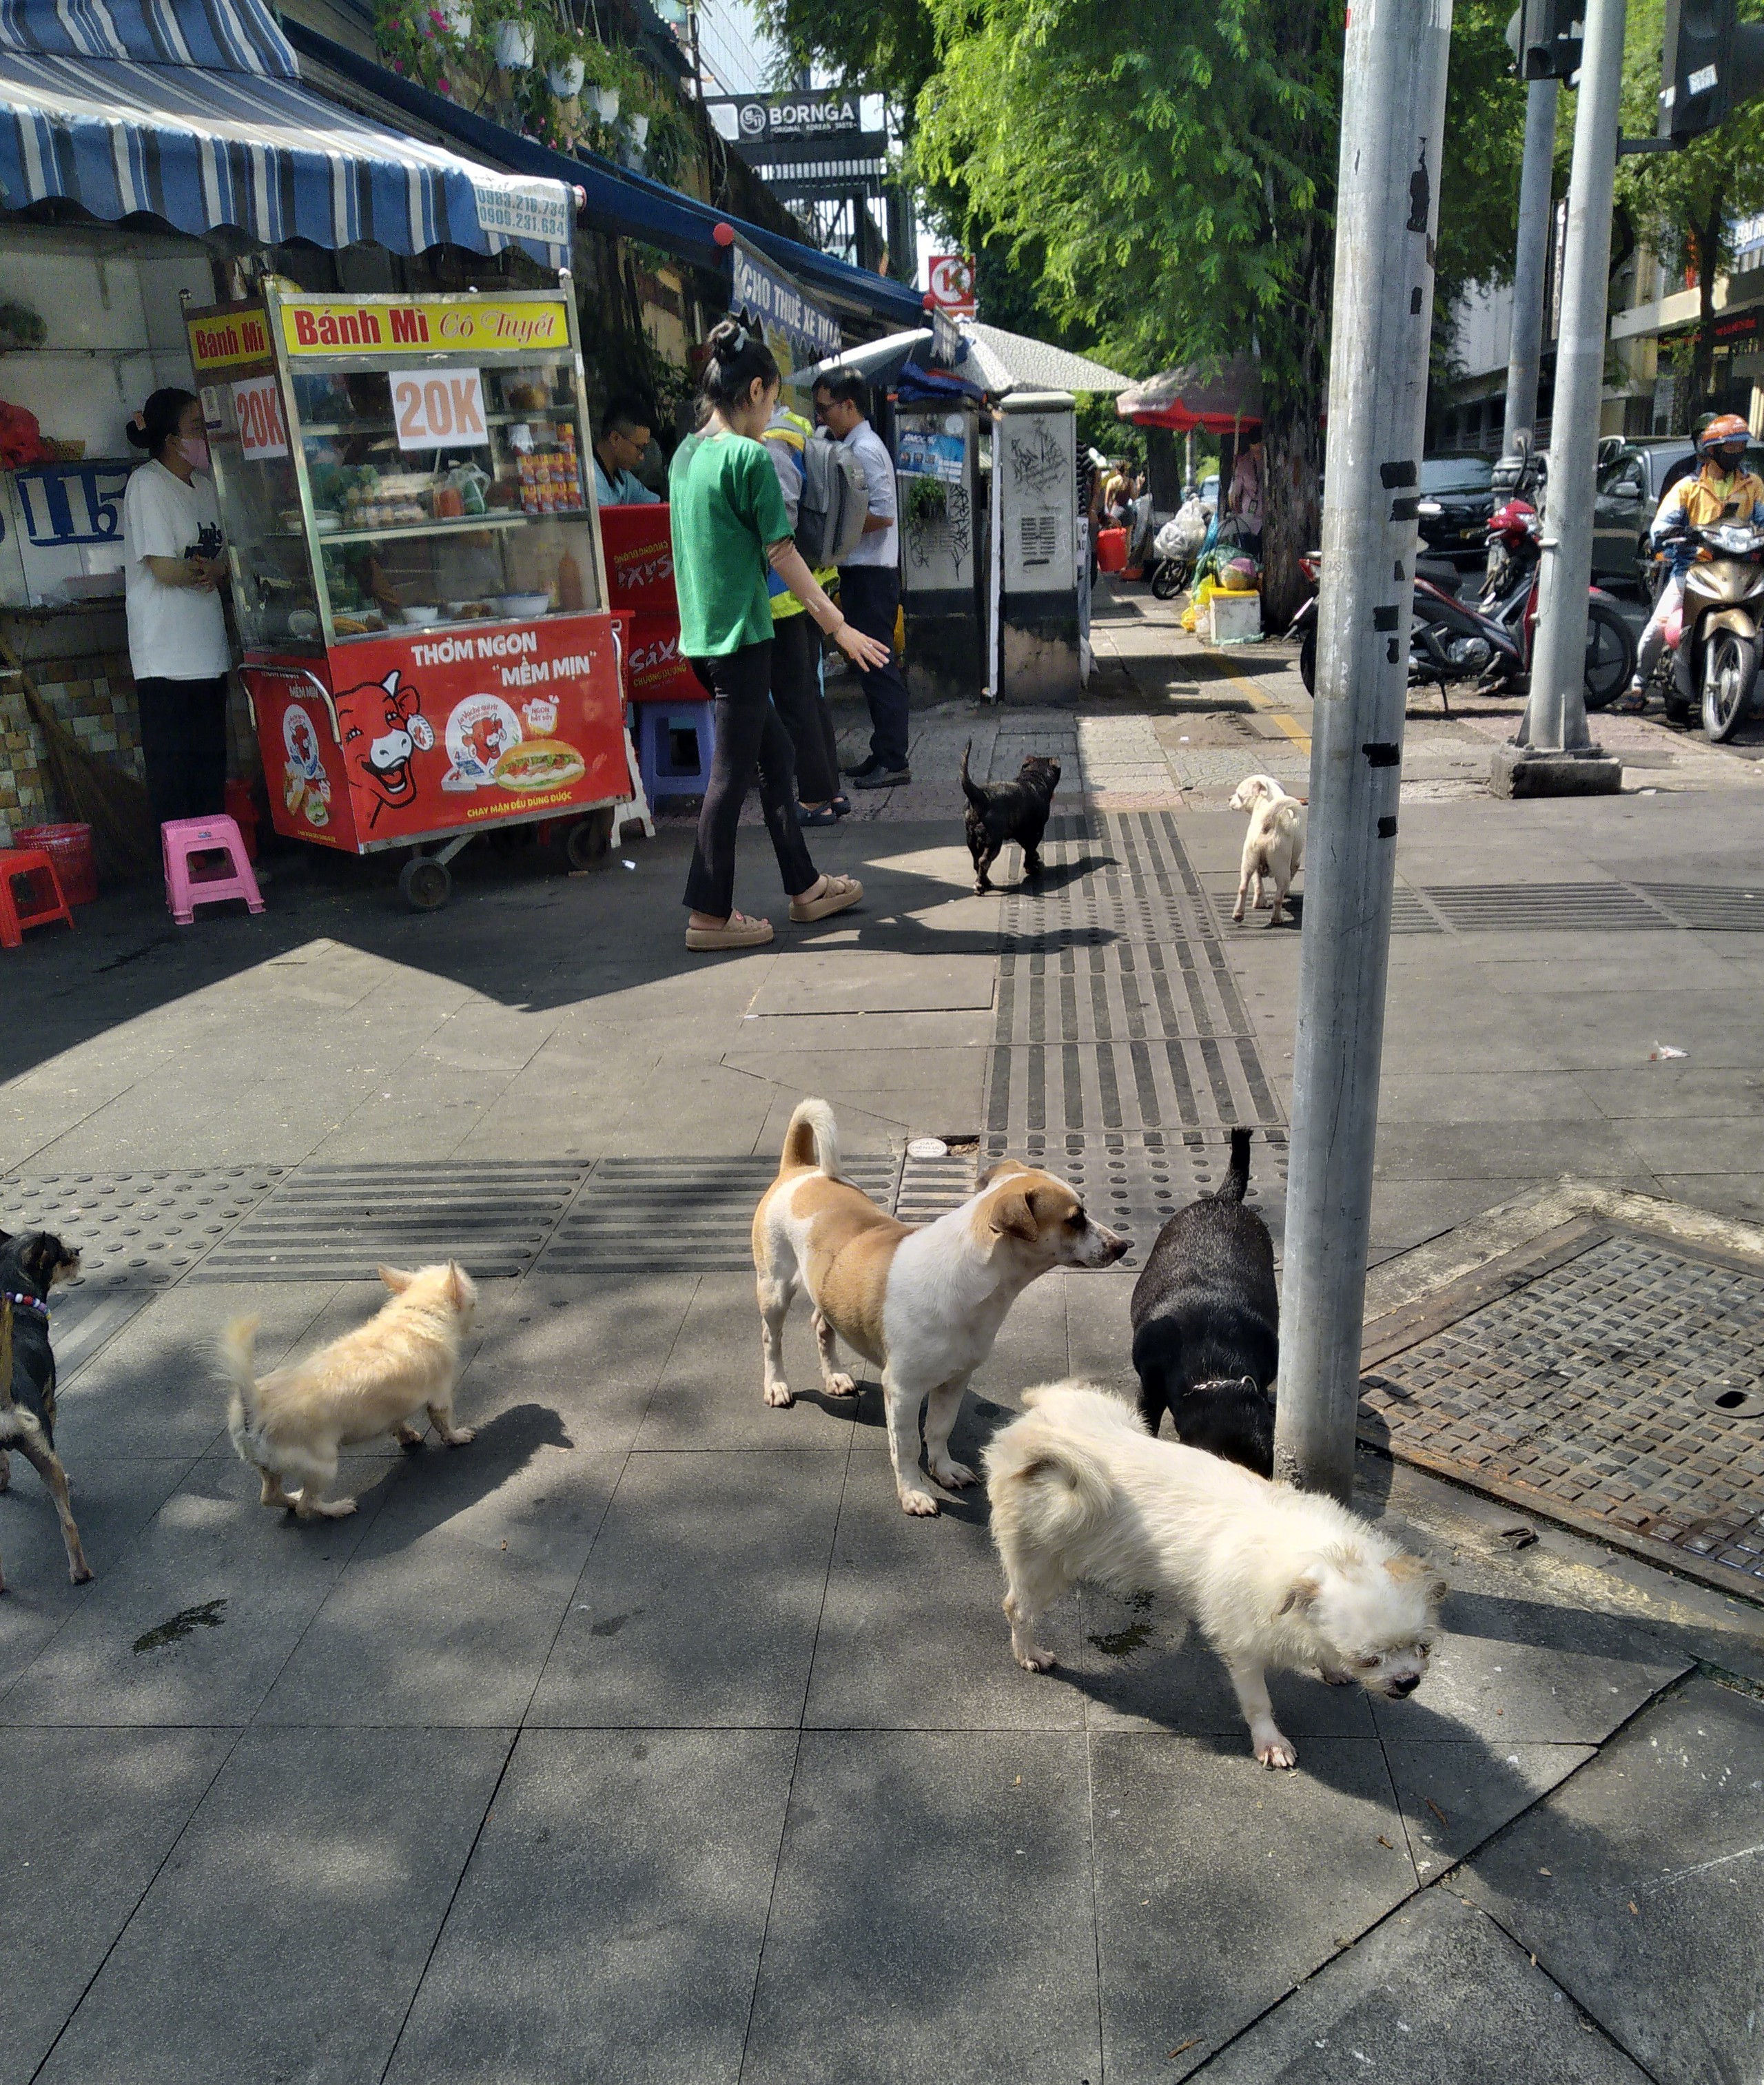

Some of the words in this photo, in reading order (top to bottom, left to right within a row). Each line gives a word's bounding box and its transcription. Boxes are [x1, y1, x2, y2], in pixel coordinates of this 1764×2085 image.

[769, 102, 855, 125] BORNGA
[943, 268, 965, 292] K
[741, 263, 771, 310] CHO
[774, 285, 801, 329] THUÊ
[803, 304, 817, 337] XE
[195, 323, 240, 360] Bánh
[241, 320, 265, 353] Mì
[294, 307, 382, 346] Bánh
[388, 307, 431, 343] Mì
[439, 310, 475, 338] Cô
[481, 309, 556, 344] Tuyết
[237, 387, 285, 448] 20K
[396, 378, 484, 438] 20K
[410, 637, 474, 667] THƠM
[478, 630, 538, 659] NGON
[467, 807, 489, 817] CHAY
